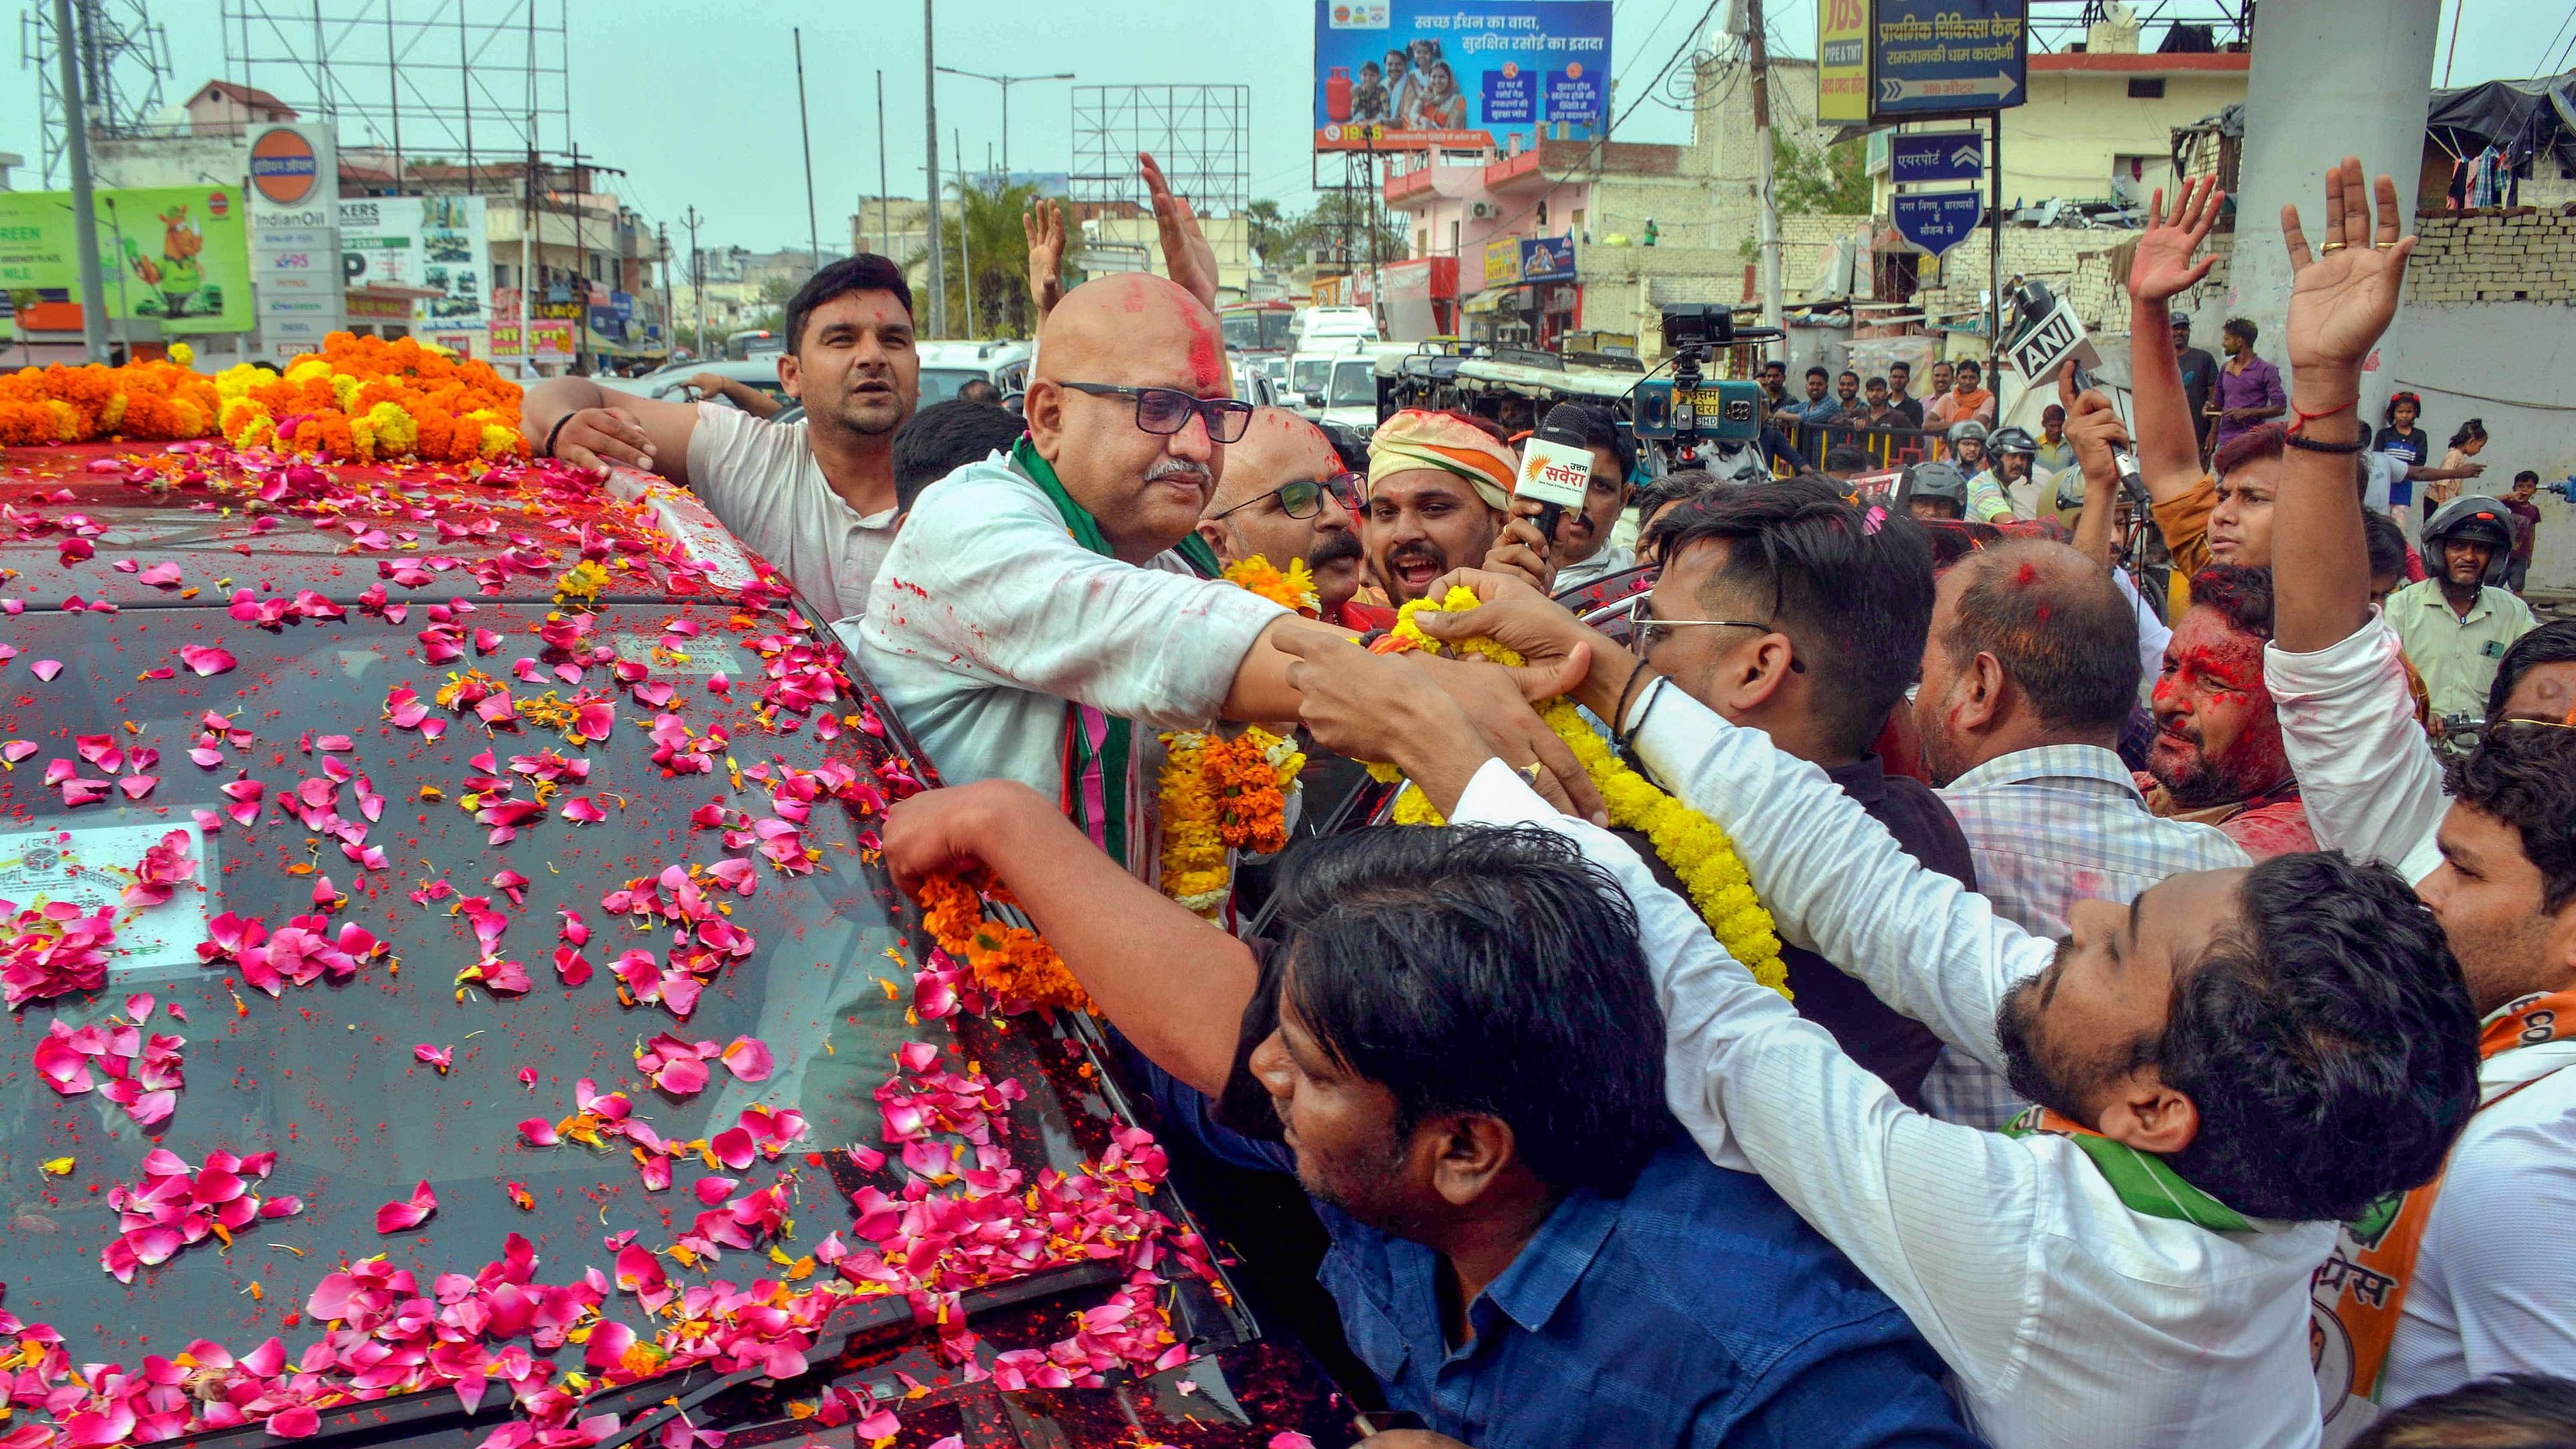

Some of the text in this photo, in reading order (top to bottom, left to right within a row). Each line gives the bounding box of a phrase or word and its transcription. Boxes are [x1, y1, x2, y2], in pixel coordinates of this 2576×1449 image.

[1415, 16, 1450, 30] स्वच्छ
[1487, 15, 1505, 30] का
[1825, 0, 1863, 33] JDS
[1879, 11, 2022, 46] प्राथमिक चिकित्सा केन्द्र
[1462, 33, 1604, 54] सुरक्षित रसोई का इरादा
[1825, 45, 1862, 63] PIPE & TMT
[1887, 41, 2015, 65] रामजानकी धाम कालोनी
[1923, 79, 1978, 94] 300 मीटर
[1342, 125, 1383, 141] 196
[1898, 149, 1940, 169] एयरपोर्ट
[1899, 202, 1915, 212] नगर
[1944, 197, 1974, 210] वाराणसी
[254, 211, 325, 226] IndianOil
[1933, 212, 1940, 222] के
[1919, 222, 1954, 235] सौजन्य से
[2025, 316, 2073, 377] ANI
[1695, 400, 1718, 414] वेरा
[1545, 464, 1586, 488] सवेरा
[1570, 462, 1588, 473] उत्तम
[69, 899, 106, 909] 266
[2521, 1010, 2556, 1050] CO
[2318, 1245, 2396, 1307] ग्रेस
